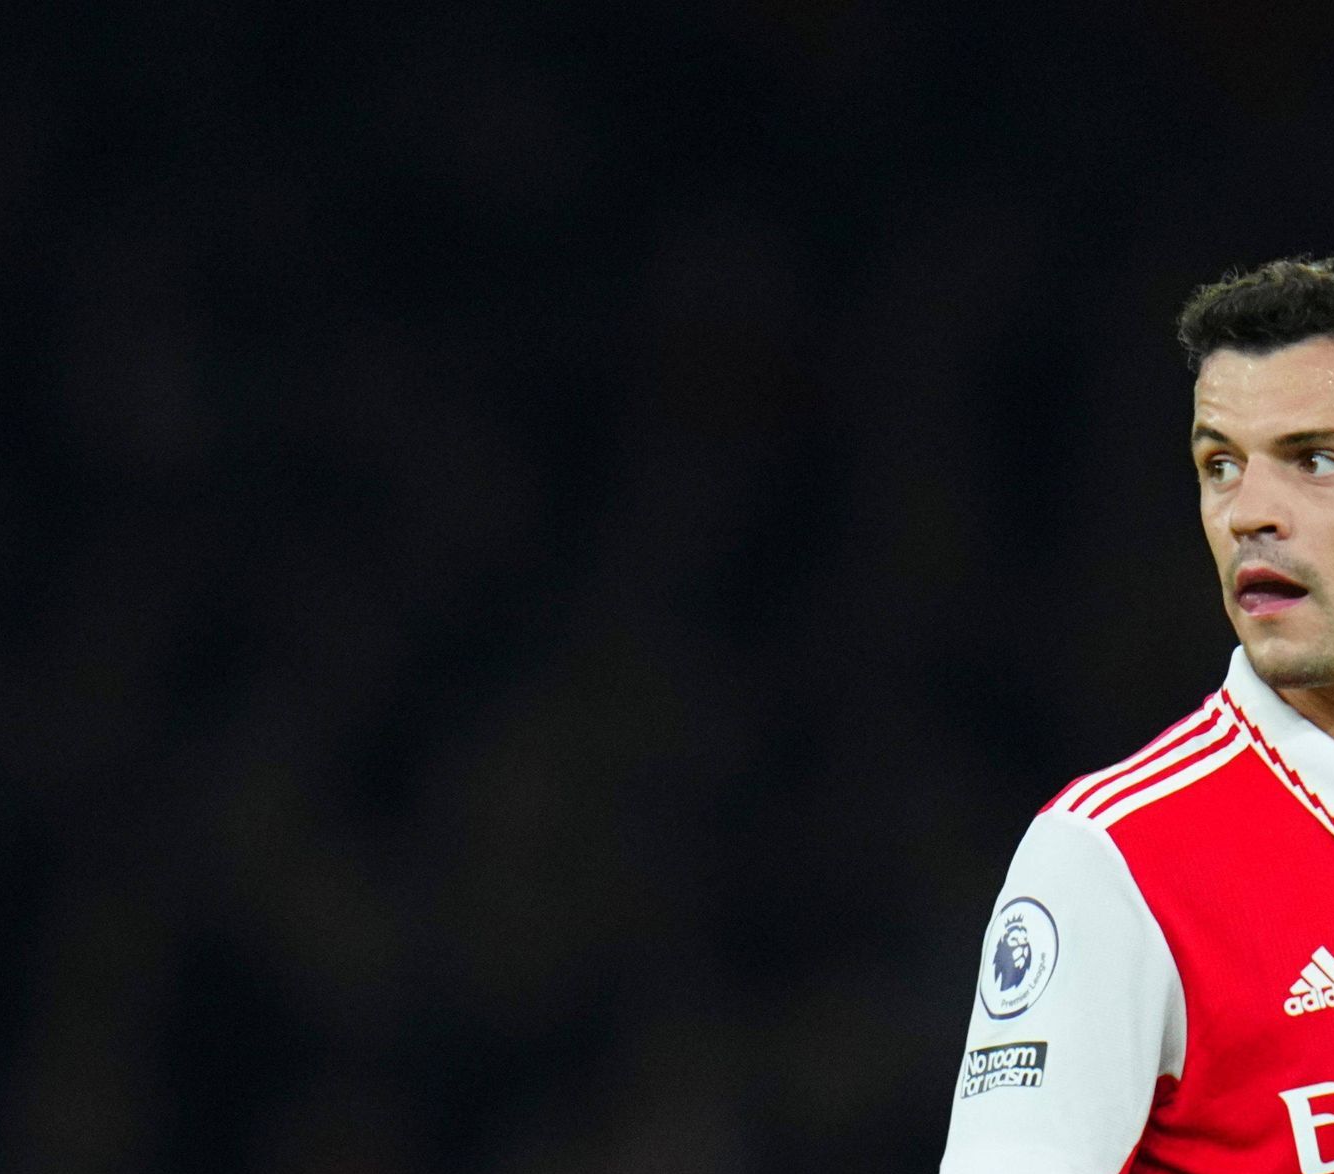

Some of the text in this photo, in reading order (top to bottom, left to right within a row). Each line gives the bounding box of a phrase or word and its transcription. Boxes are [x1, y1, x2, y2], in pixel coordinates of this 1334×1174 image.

[1028, 952, 1046, 989] League
[967, 1046, 1037, 1076] No room
